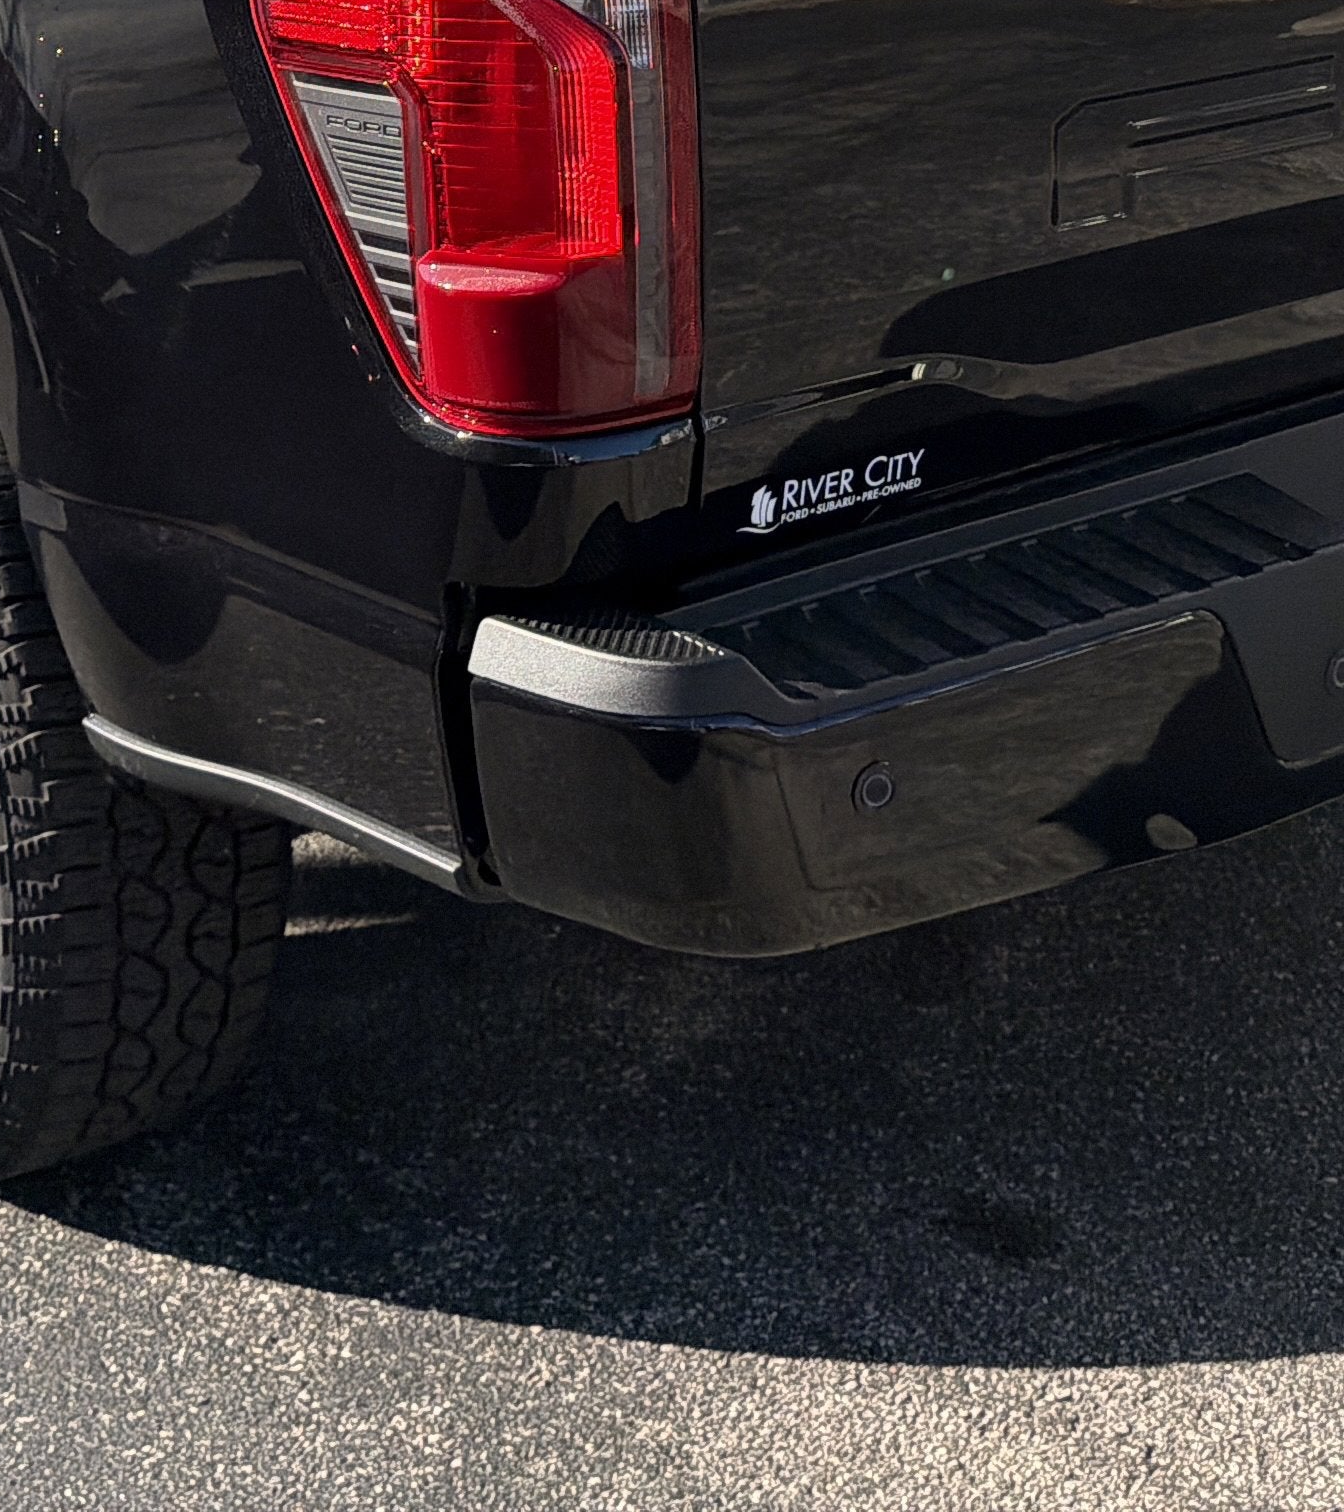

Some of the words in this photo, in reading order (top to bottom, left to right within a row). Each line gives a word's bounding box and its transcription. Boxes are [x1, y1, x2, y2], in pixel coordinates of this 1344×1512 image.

[326, 114, 402, 138] FORD
[780, 507, 809, 524] FORD
[816, 494, 856, 515] SUBARU
[861, 477, 922, 502] PRE-OWNED
[782, 468, 855, 511] RIVER
[864, 448, 926, 487] CITY
